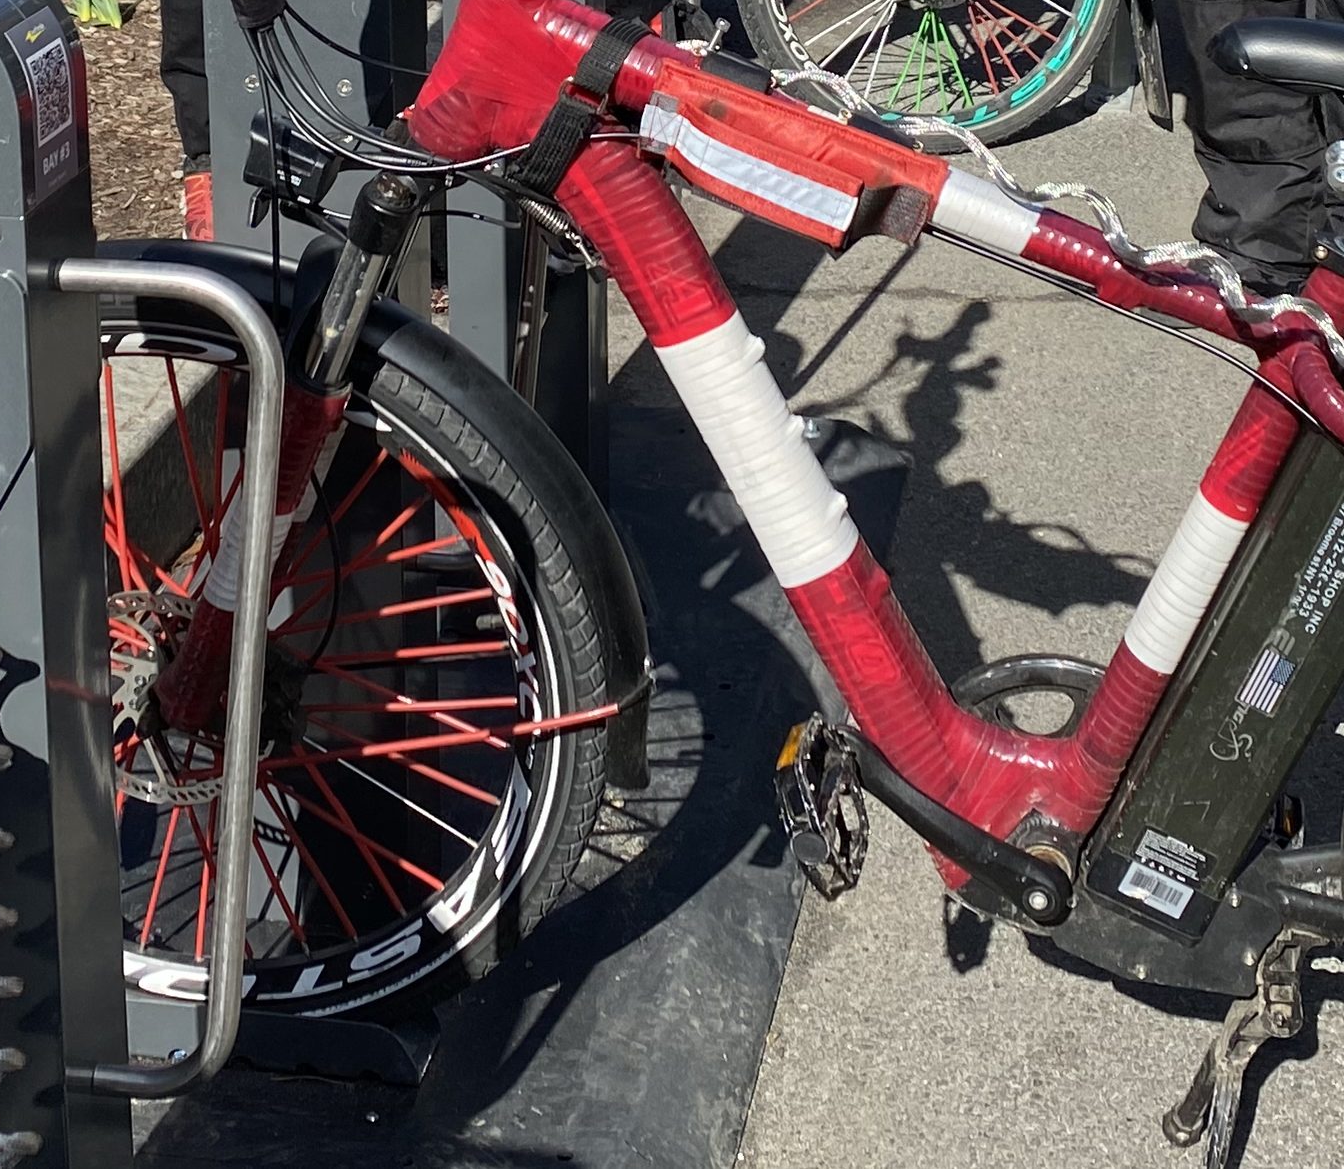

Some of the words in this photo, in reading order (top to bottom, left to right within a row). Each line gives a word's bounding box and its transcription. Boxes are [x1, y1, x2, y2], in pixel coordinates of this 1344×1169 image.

[43, 149, 61, 177] BAY
[60, 140, 71, 163] #3
[1317, 517, 1344, 556] Broome
[1305, 609, 1325, 635] INC
[474, 553, 543, 737] 90XC
